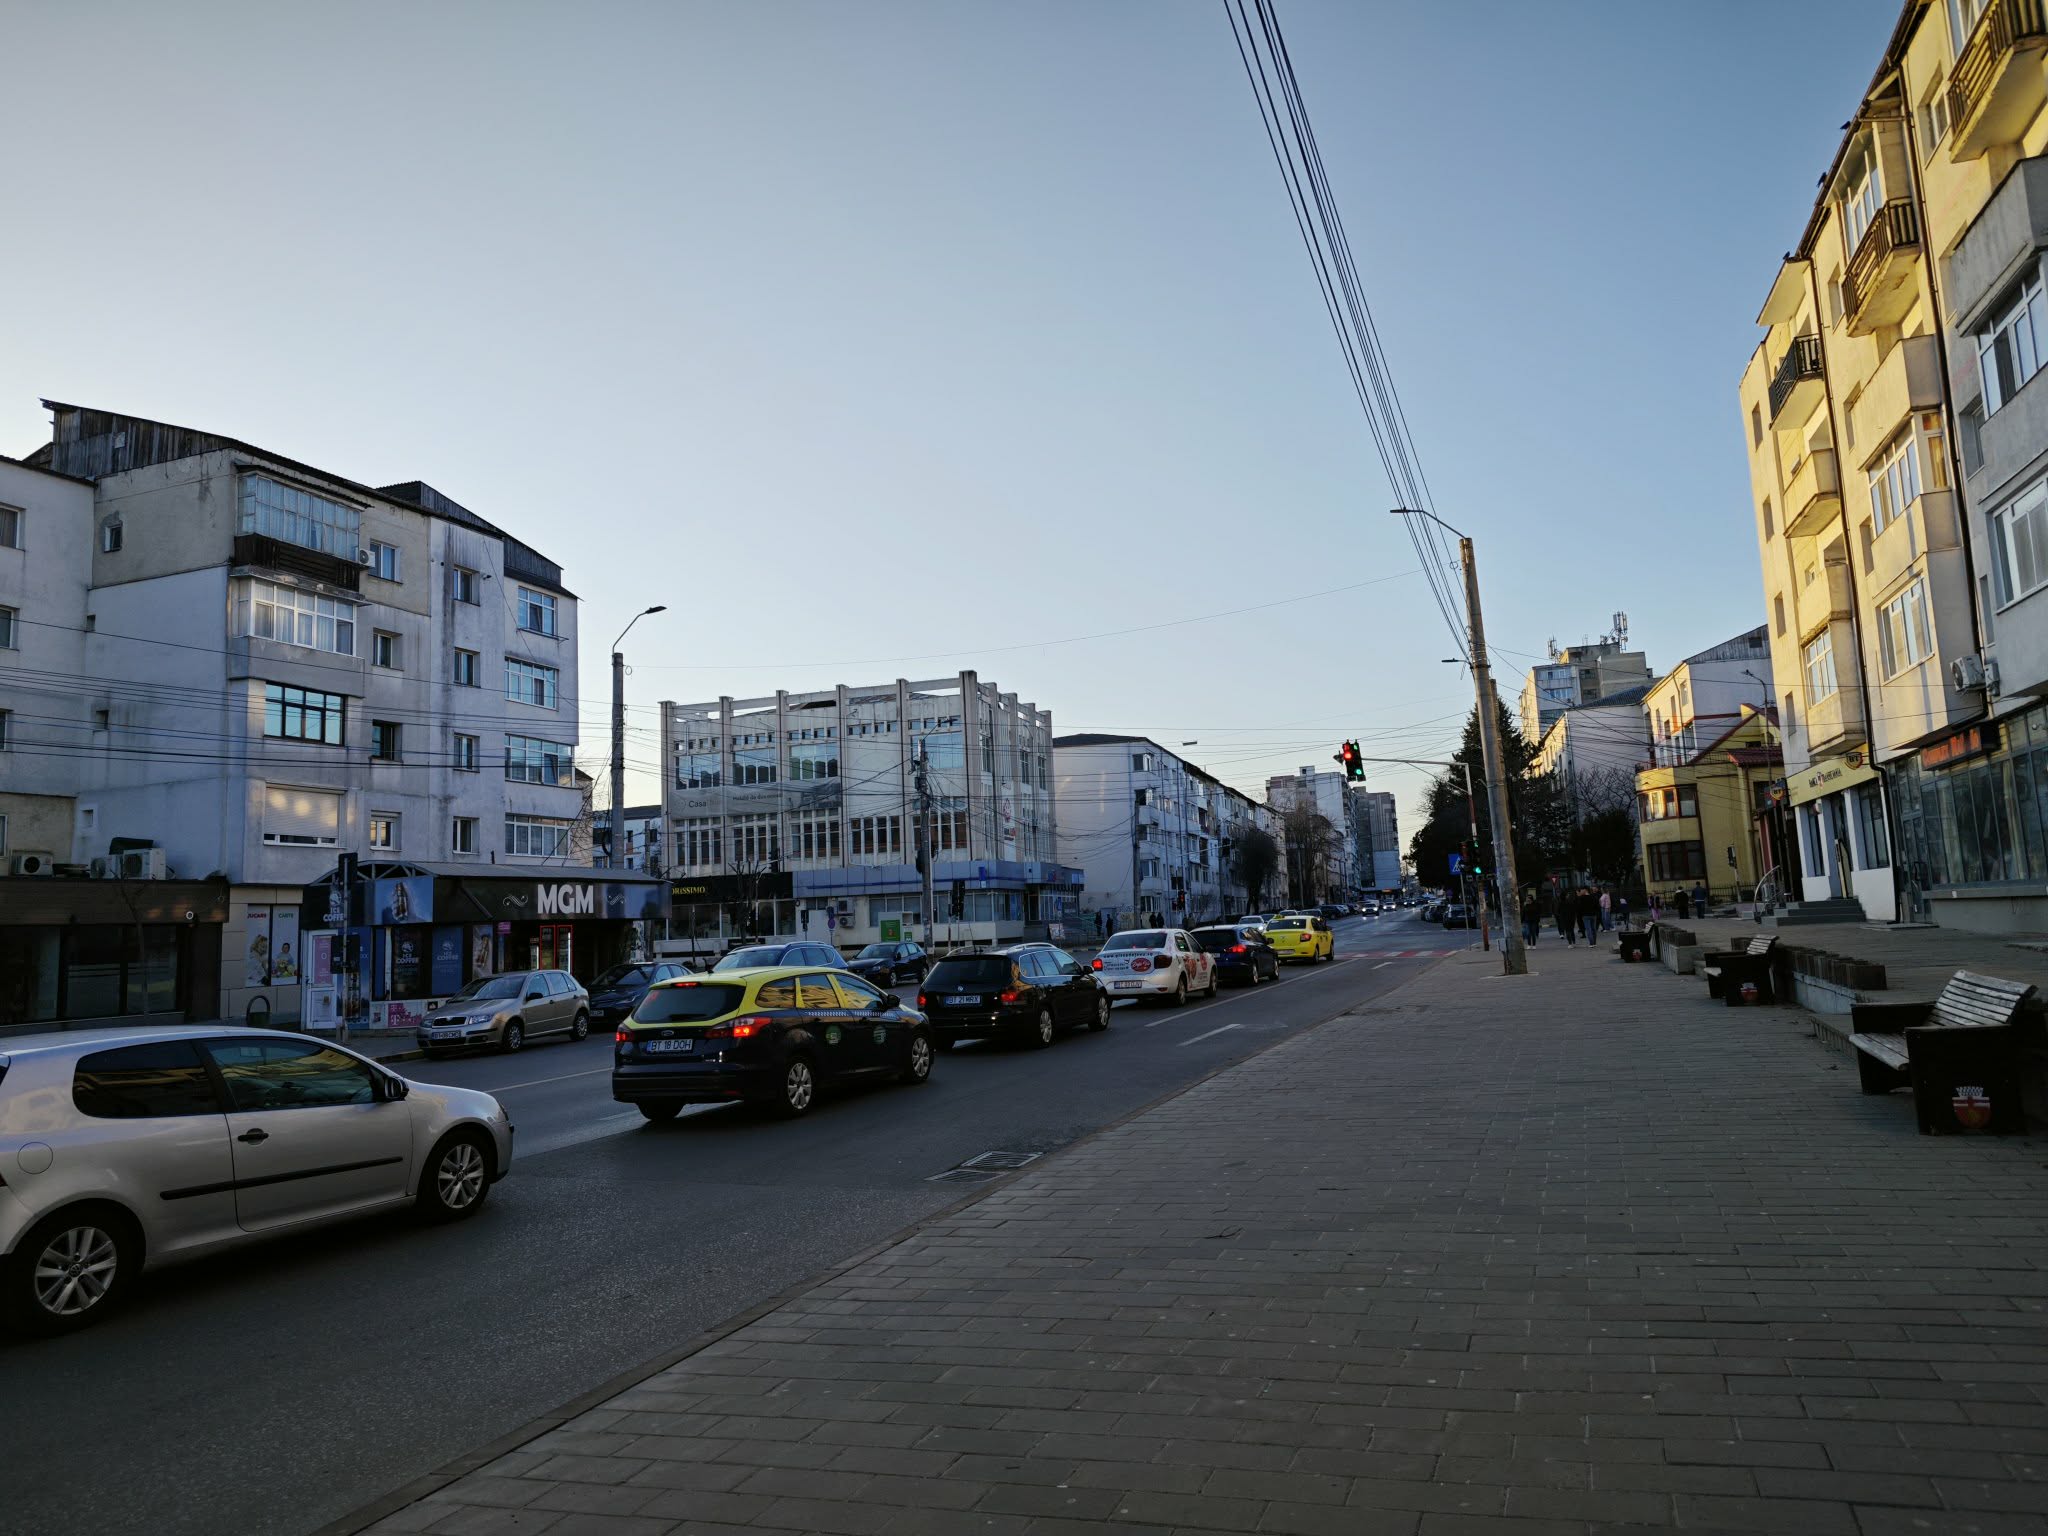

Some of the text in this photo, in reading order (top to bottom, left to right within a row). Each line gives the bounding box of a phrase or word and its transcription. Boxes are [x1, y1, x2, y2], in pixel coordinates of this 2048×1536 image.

[688, 800, 707, 808] Casa
[537, 884, 594, 914] MGM
[323, 913, 344, 922] COFFE
[651, 1039, 691, 1050] BT 18 DOH
